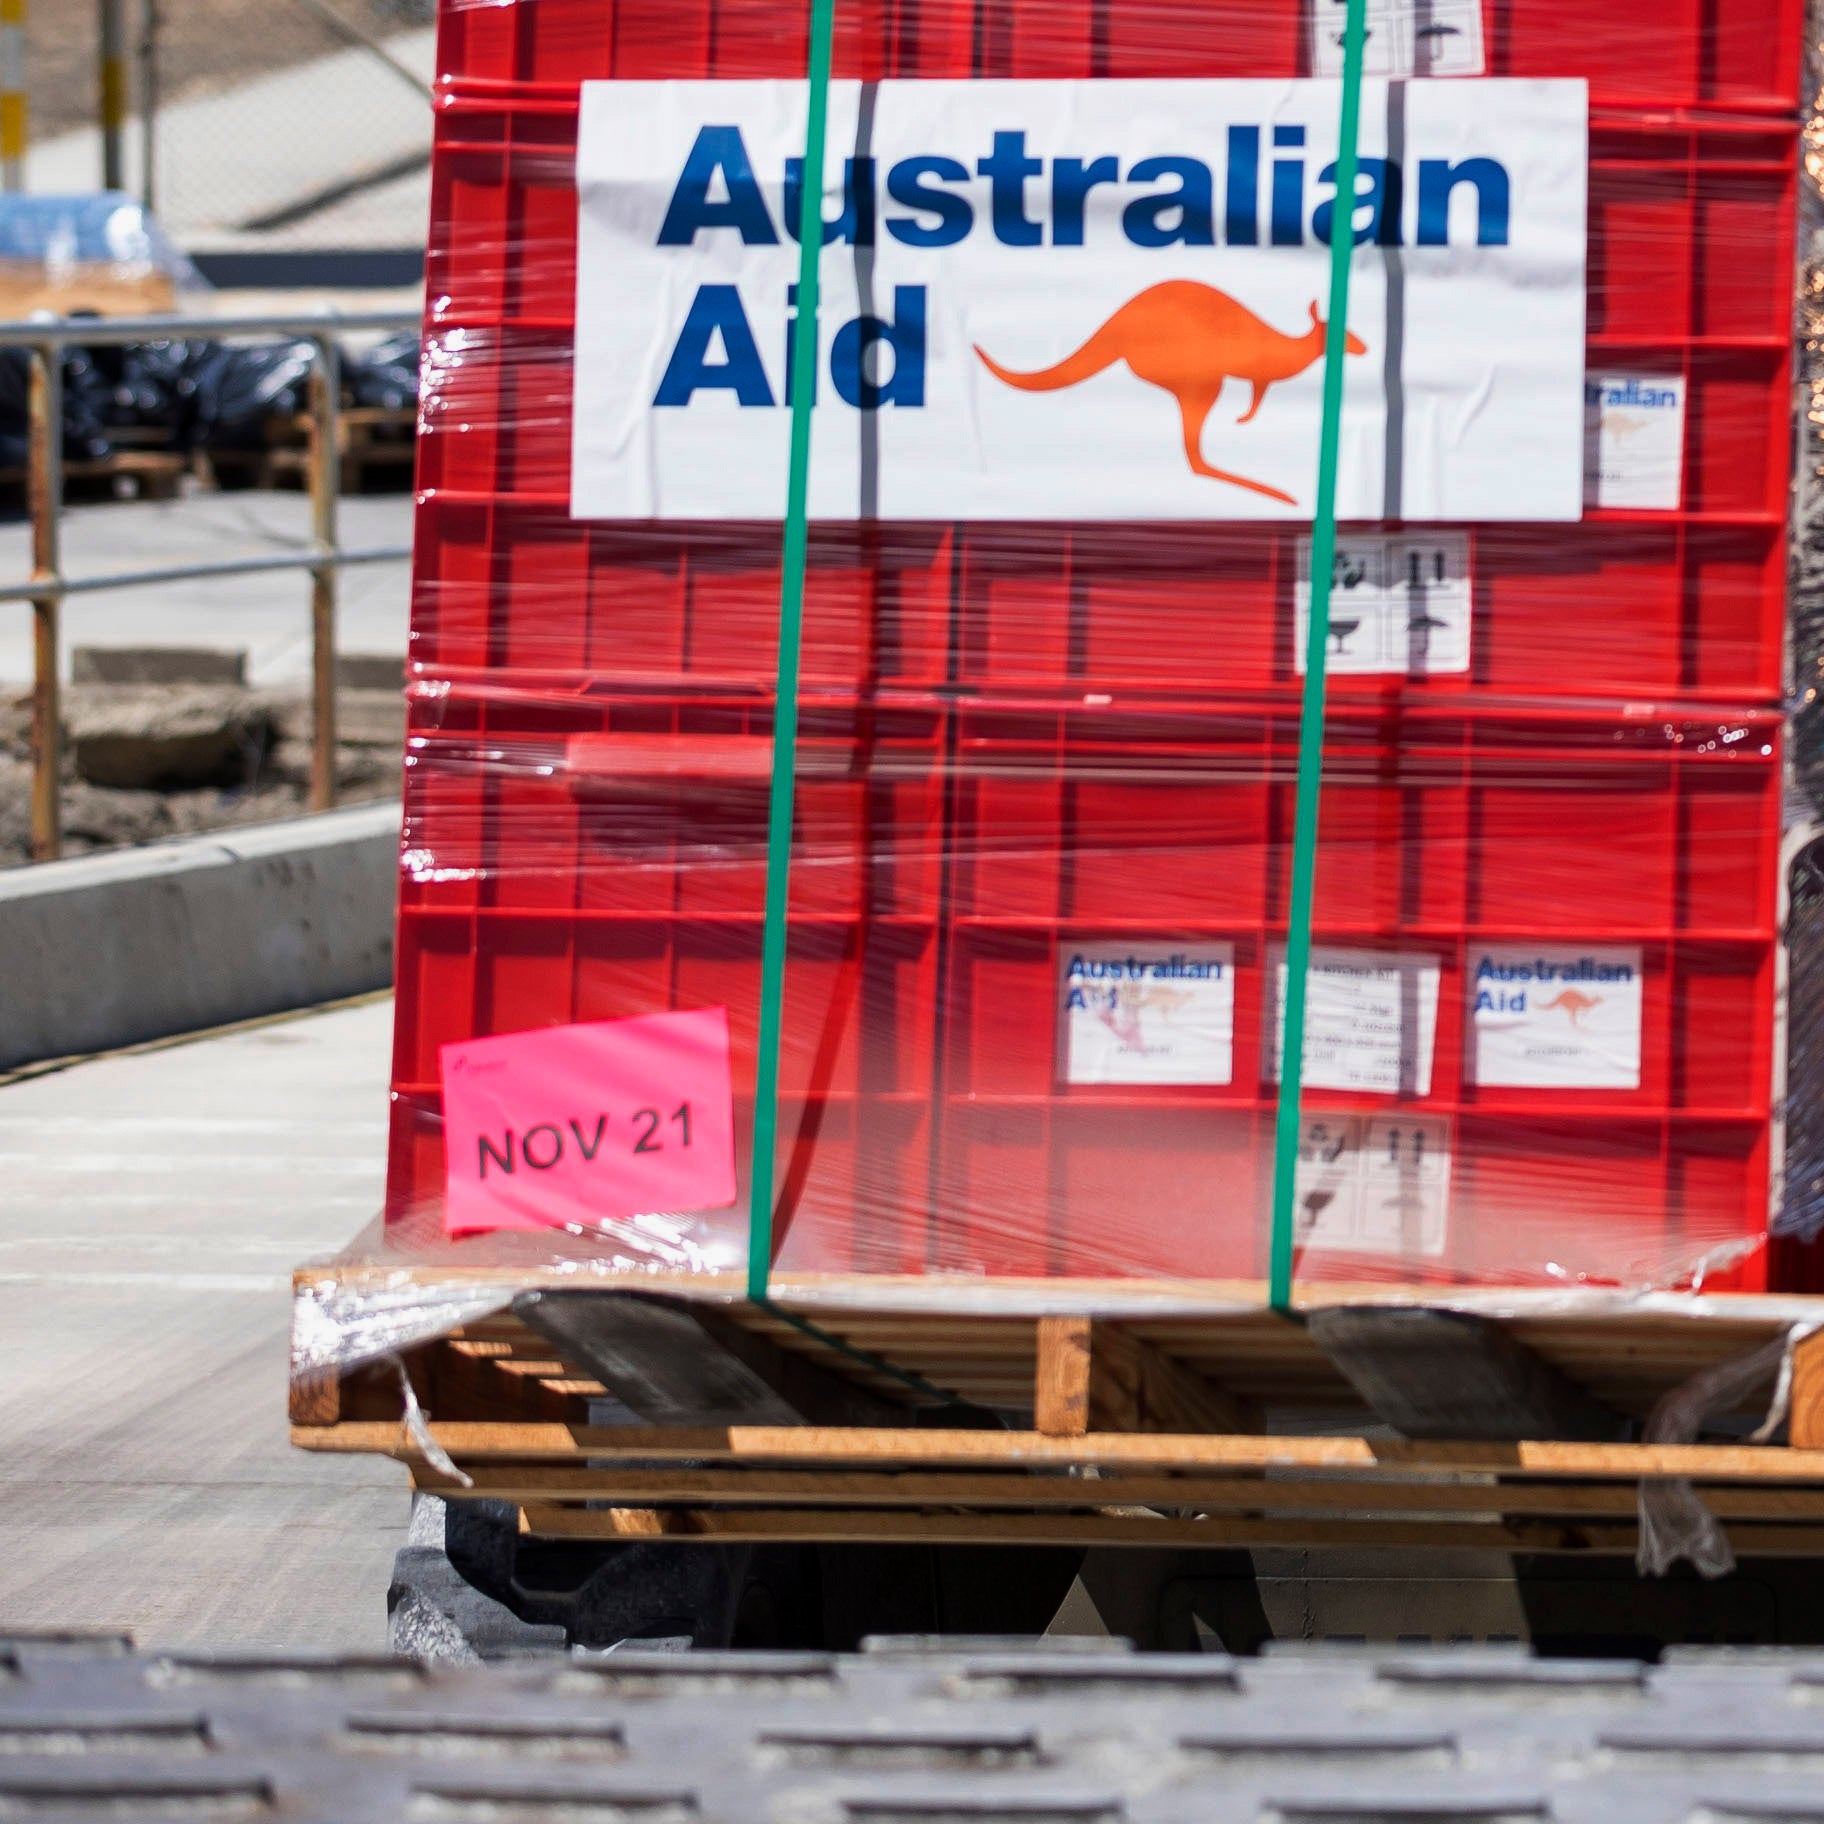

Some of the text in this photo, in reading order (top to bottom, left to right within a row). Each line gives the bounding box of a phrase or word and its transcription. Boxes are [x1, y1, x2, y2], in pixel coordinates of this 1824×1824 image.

[656, 124, 1511, 248] Australian
[1066, 953, 1222, 980] Australian
[1476, 956, 1632, 982] Australian
[1475, 990, 1527, 1012] Aid
[477, 1103, 693, 1179] NOV 21
